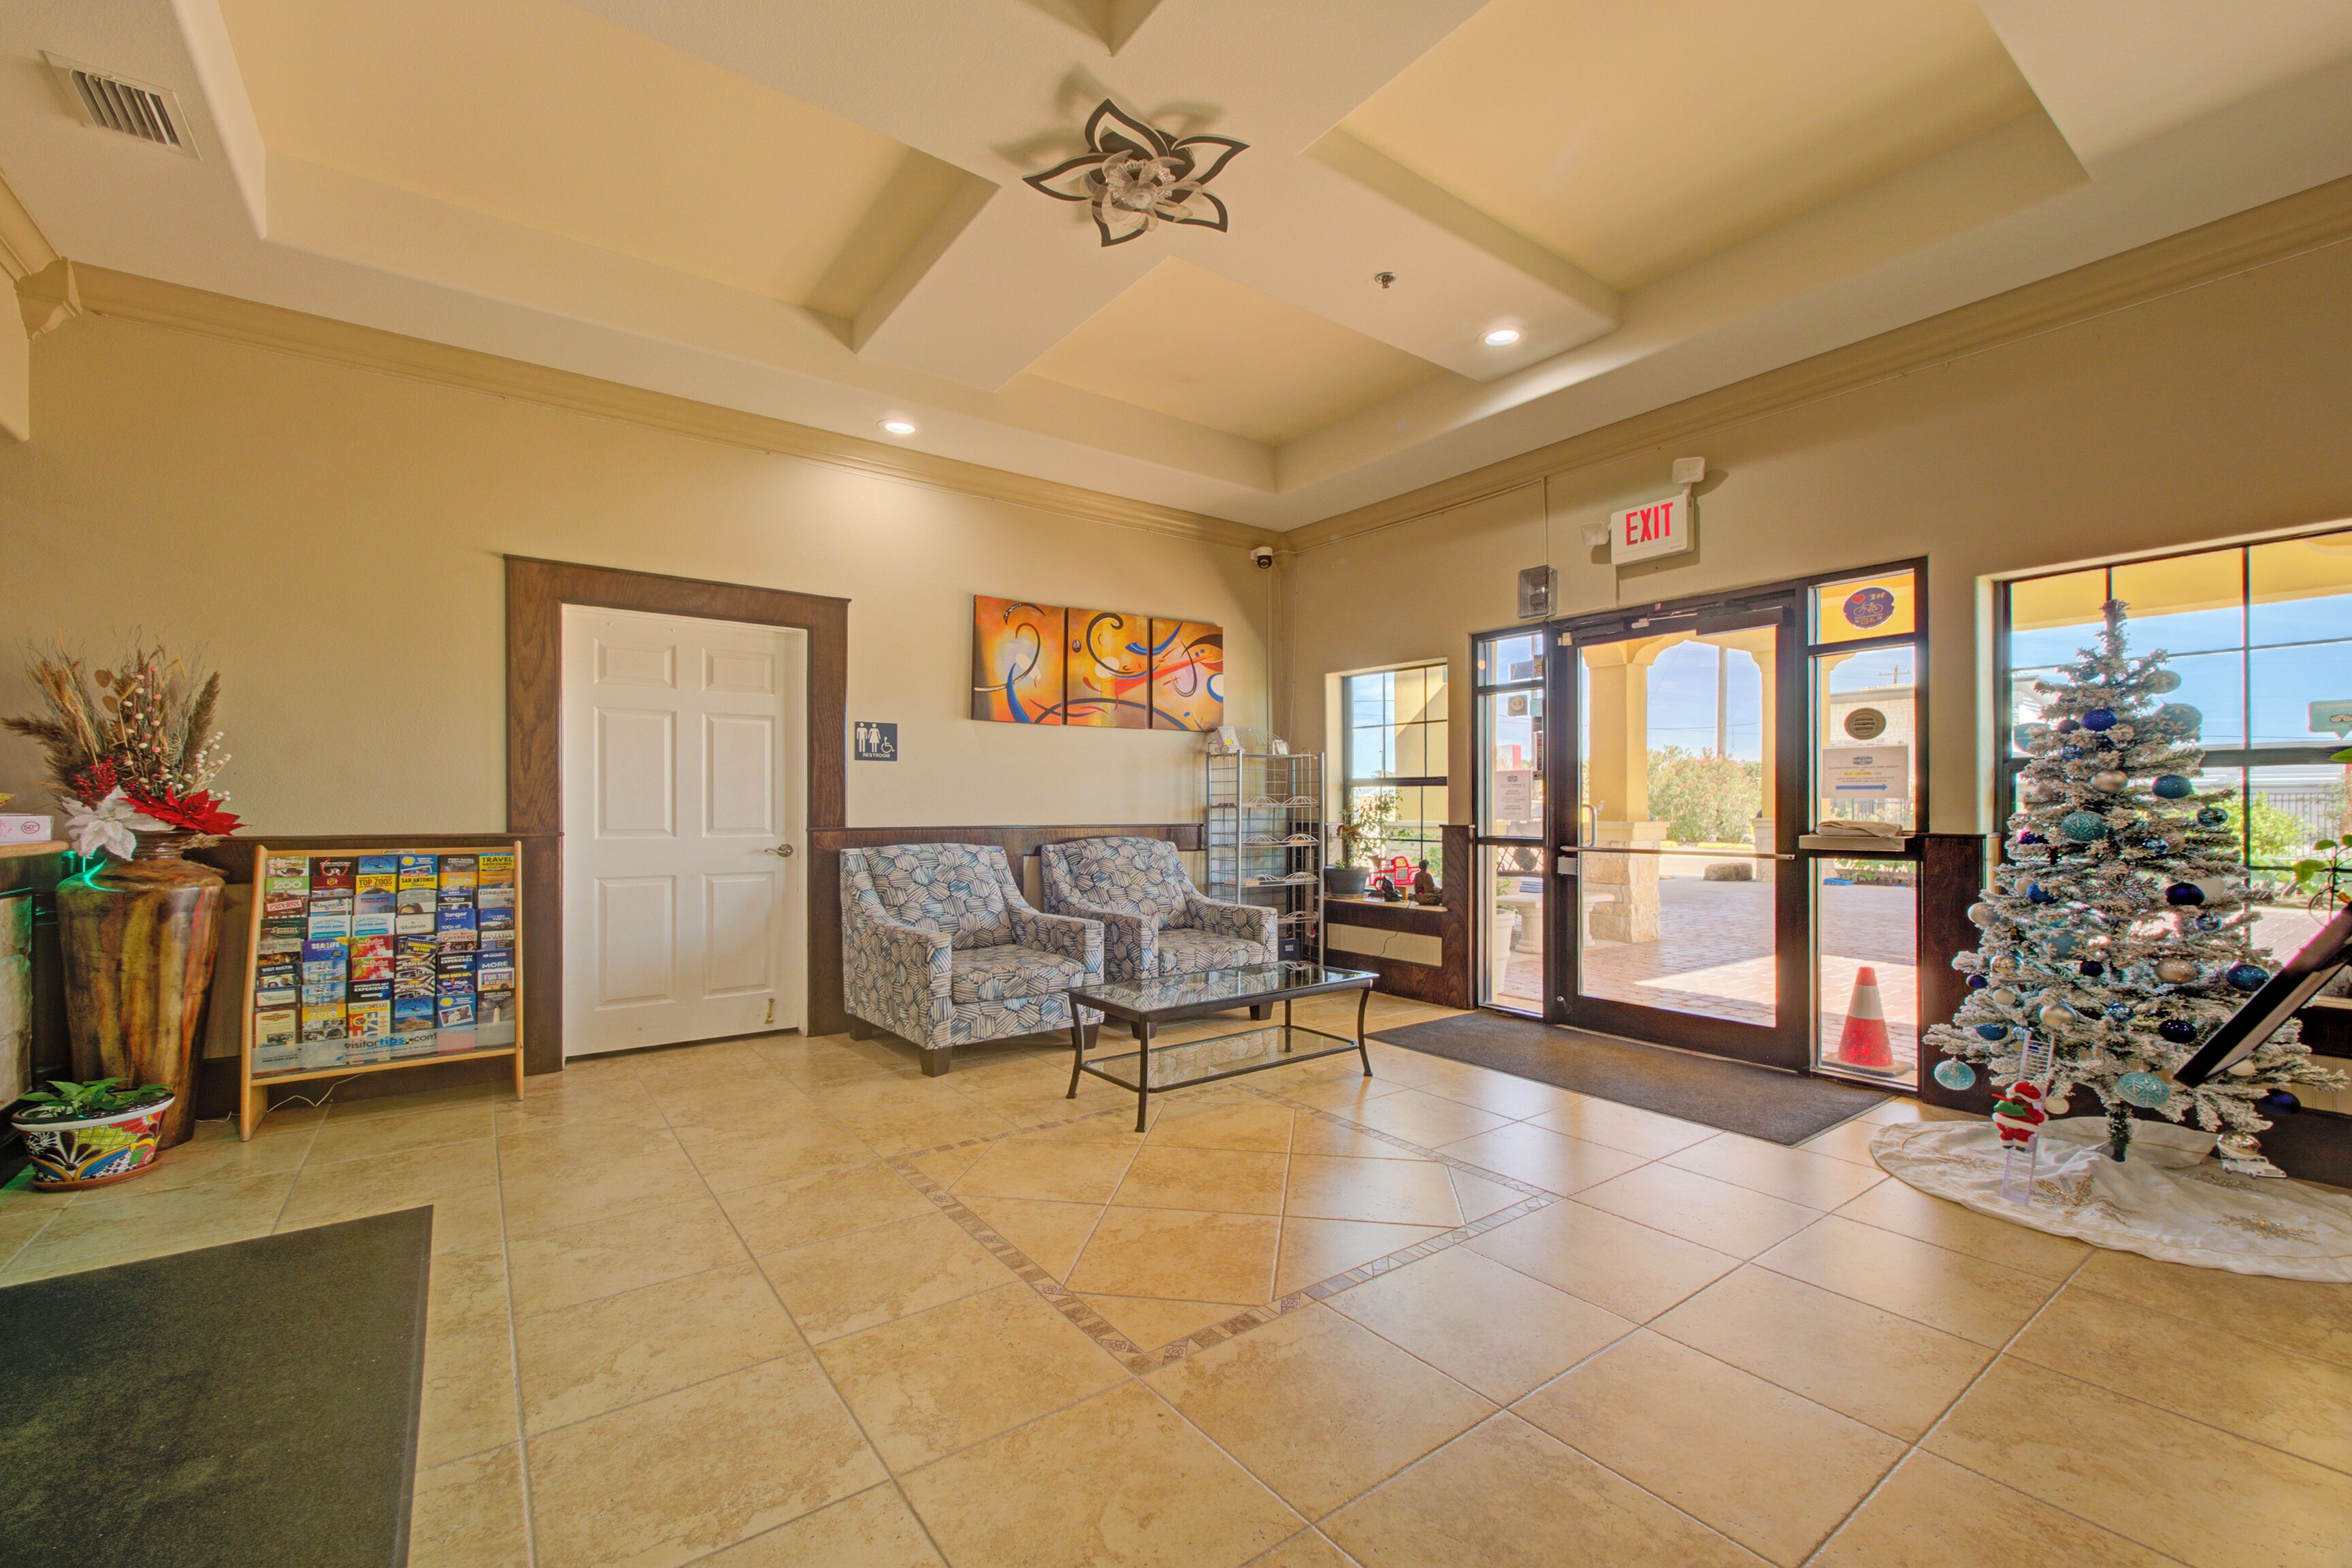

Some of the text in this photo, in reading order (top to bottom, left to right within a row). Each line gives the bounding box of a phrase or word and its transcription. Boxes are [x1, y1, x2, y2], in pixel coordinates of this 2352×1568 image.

[1625, 502, 1674, 546] EXIT
[274, 881, 302, 889] ZOO
[269, 900, 300, 911] CAVERNS
[310, 1011, 338, 1020] ZOO
